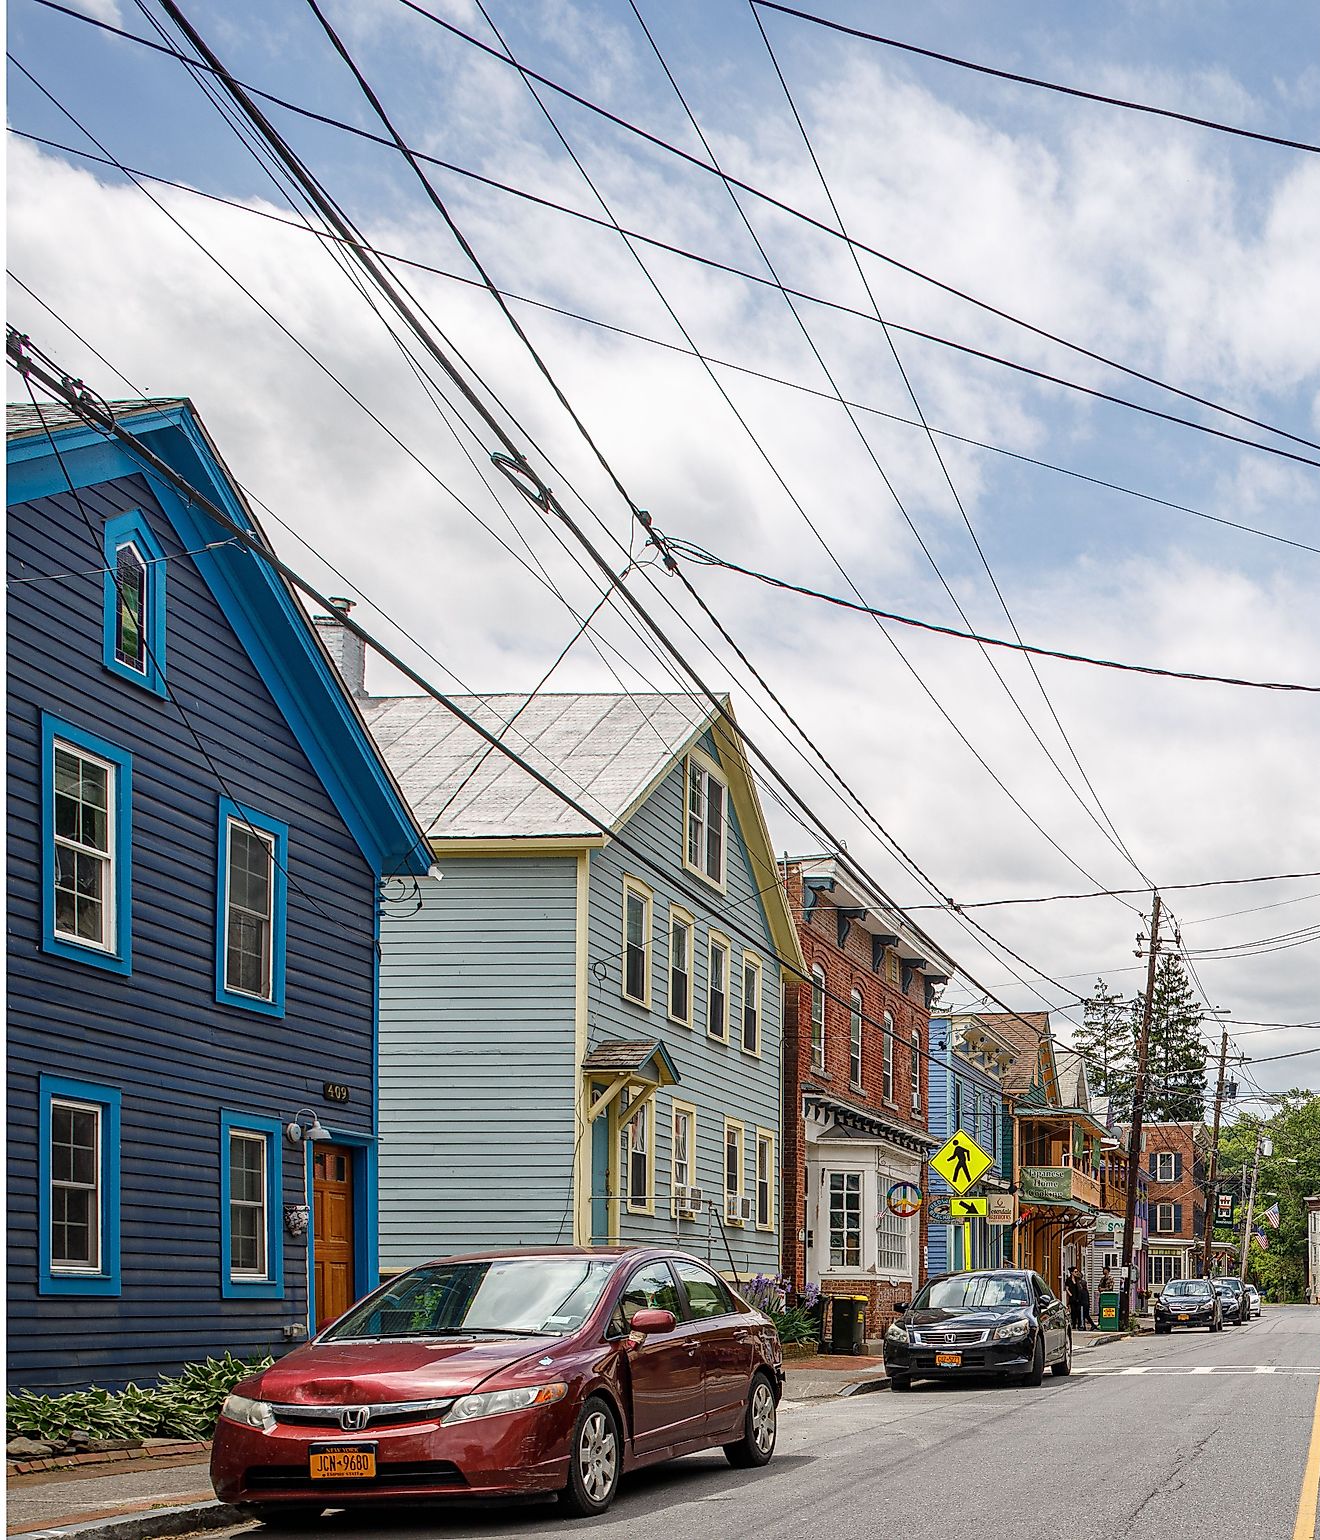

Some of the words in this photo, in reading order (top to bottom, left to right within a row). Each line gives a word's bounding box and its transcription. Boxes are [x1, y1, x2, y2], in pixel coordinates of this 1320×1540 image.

[328, 1084, 347, 1099] 409
[1029, 1169, 1064, 1177] Japanese
[1033, 1179, 1059, 1187] Home
[1028, 1190, 1064, 1199] Cooking
